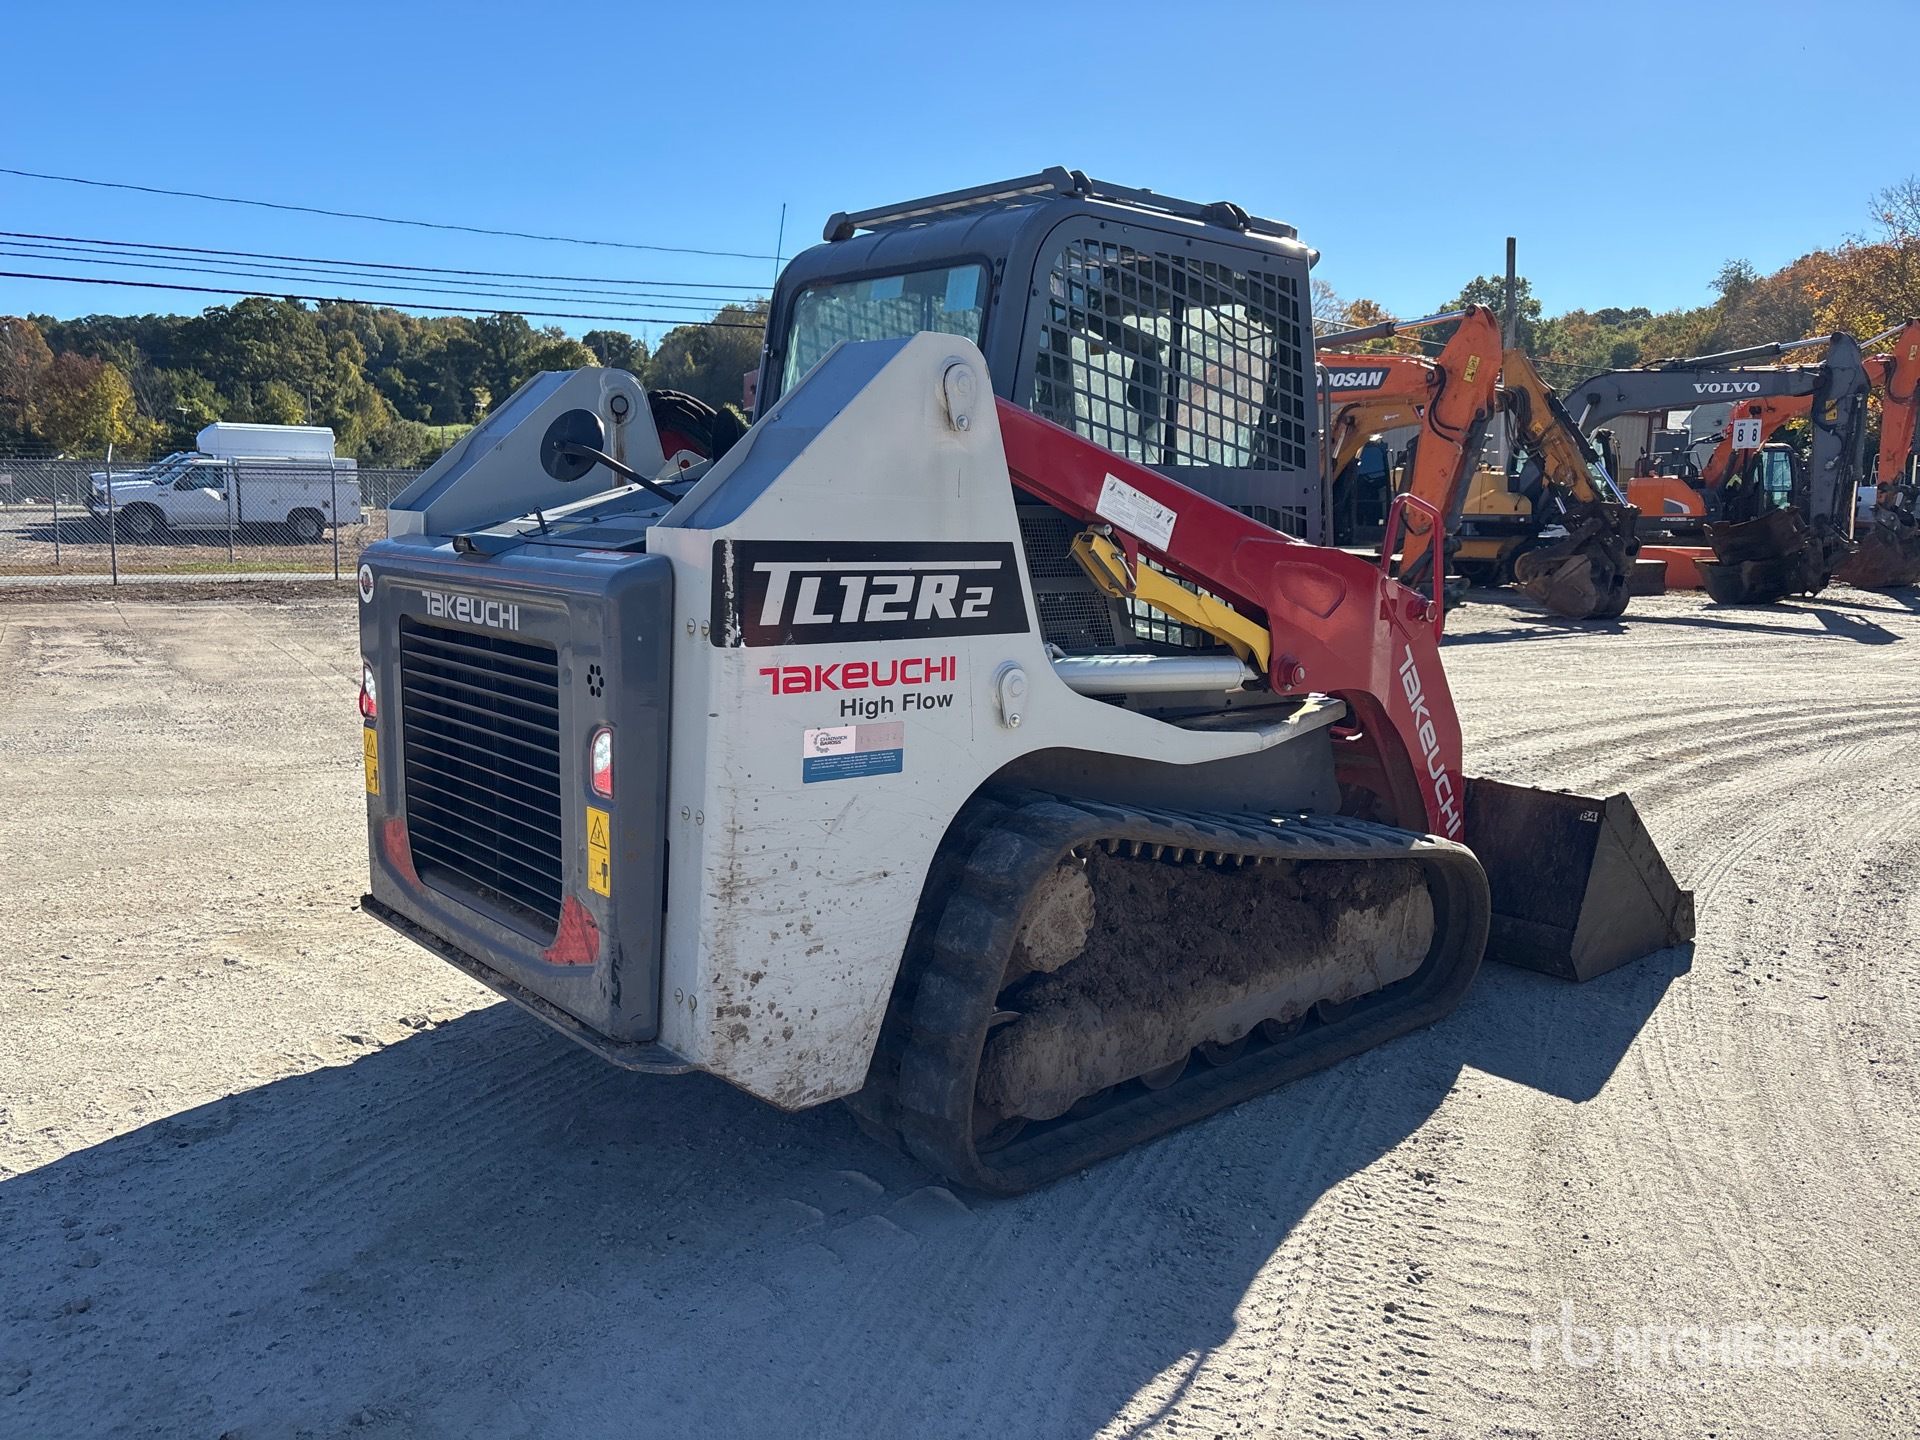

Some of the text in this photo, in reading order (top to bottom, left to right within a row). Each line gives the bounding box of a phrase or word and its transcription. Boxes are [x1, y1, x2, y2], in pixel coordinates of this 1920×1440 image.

[1693, 382, 1760, 394] VOLVO
[1737, 428, 1744, 442] 8
[1752, 428, 1757, 442] 8
[753, 561, 1002, 626] TL12R2
[840, 693, 953, 719] High Flow
[819, 734, 848, 742] CHADWICK
